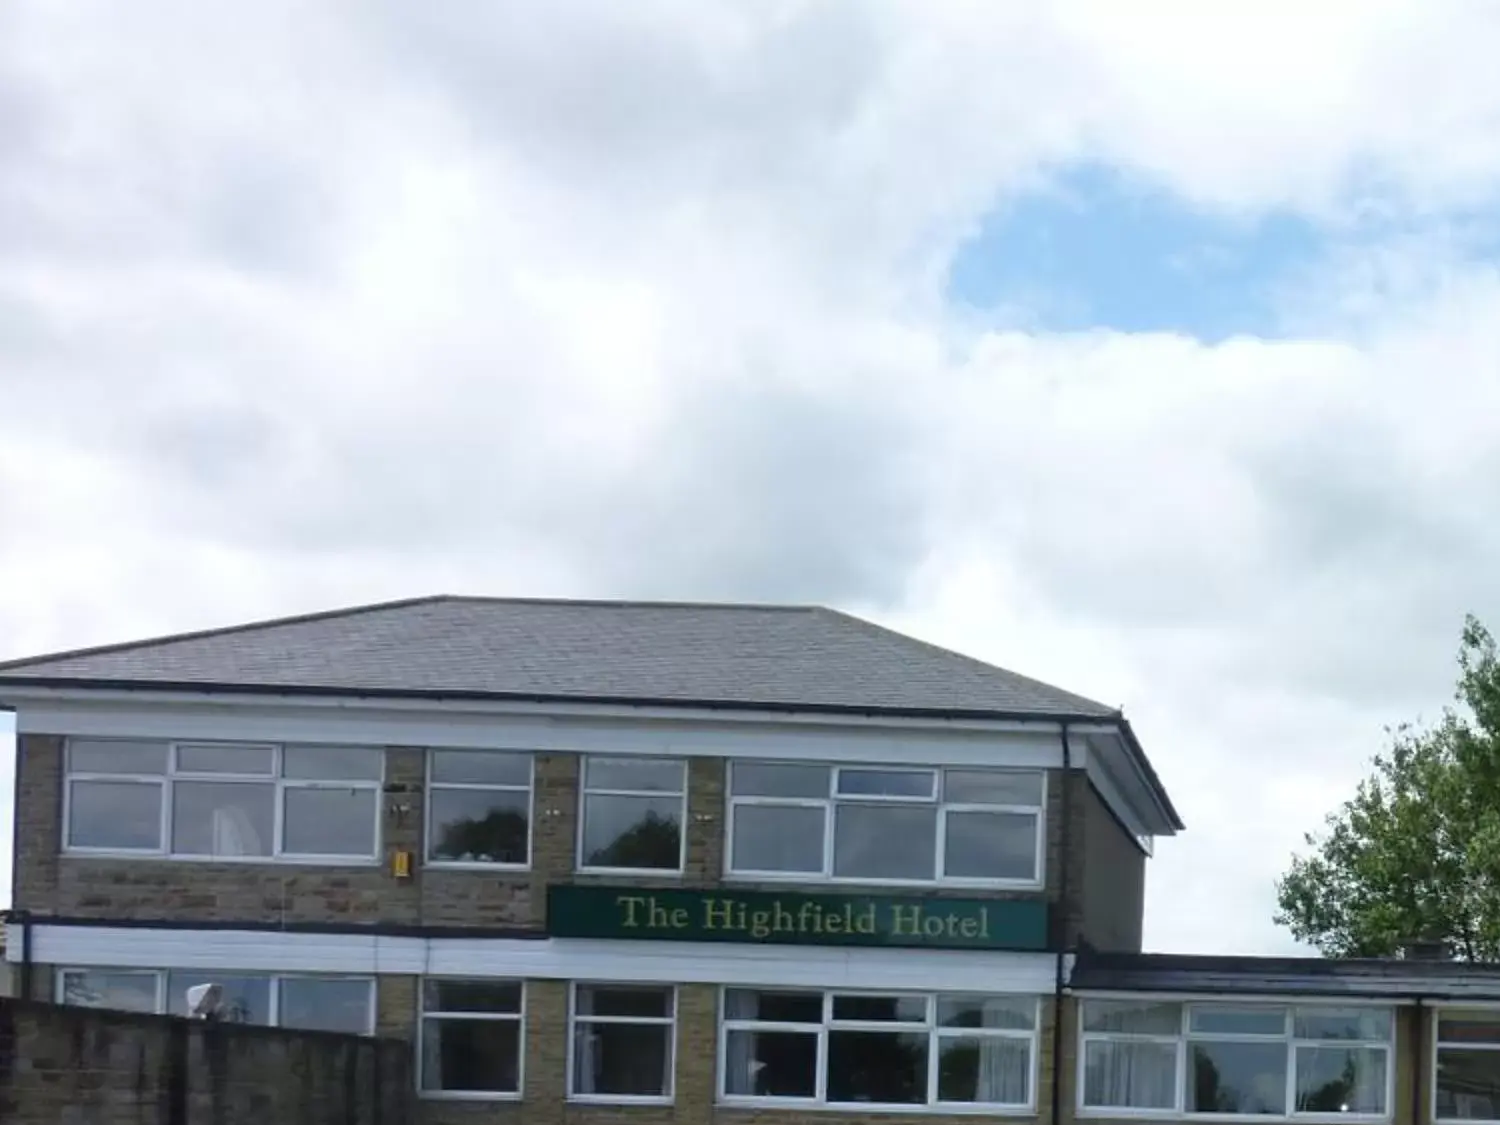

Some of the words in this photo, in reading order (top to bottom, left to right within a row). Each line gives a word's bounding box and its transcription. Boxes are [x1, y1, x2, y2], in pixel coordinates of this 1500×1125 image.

[617, 896, 689, 927] The
[702, 899, 876, 938] Highfield
[890, 903, 989, 938] Hotel
